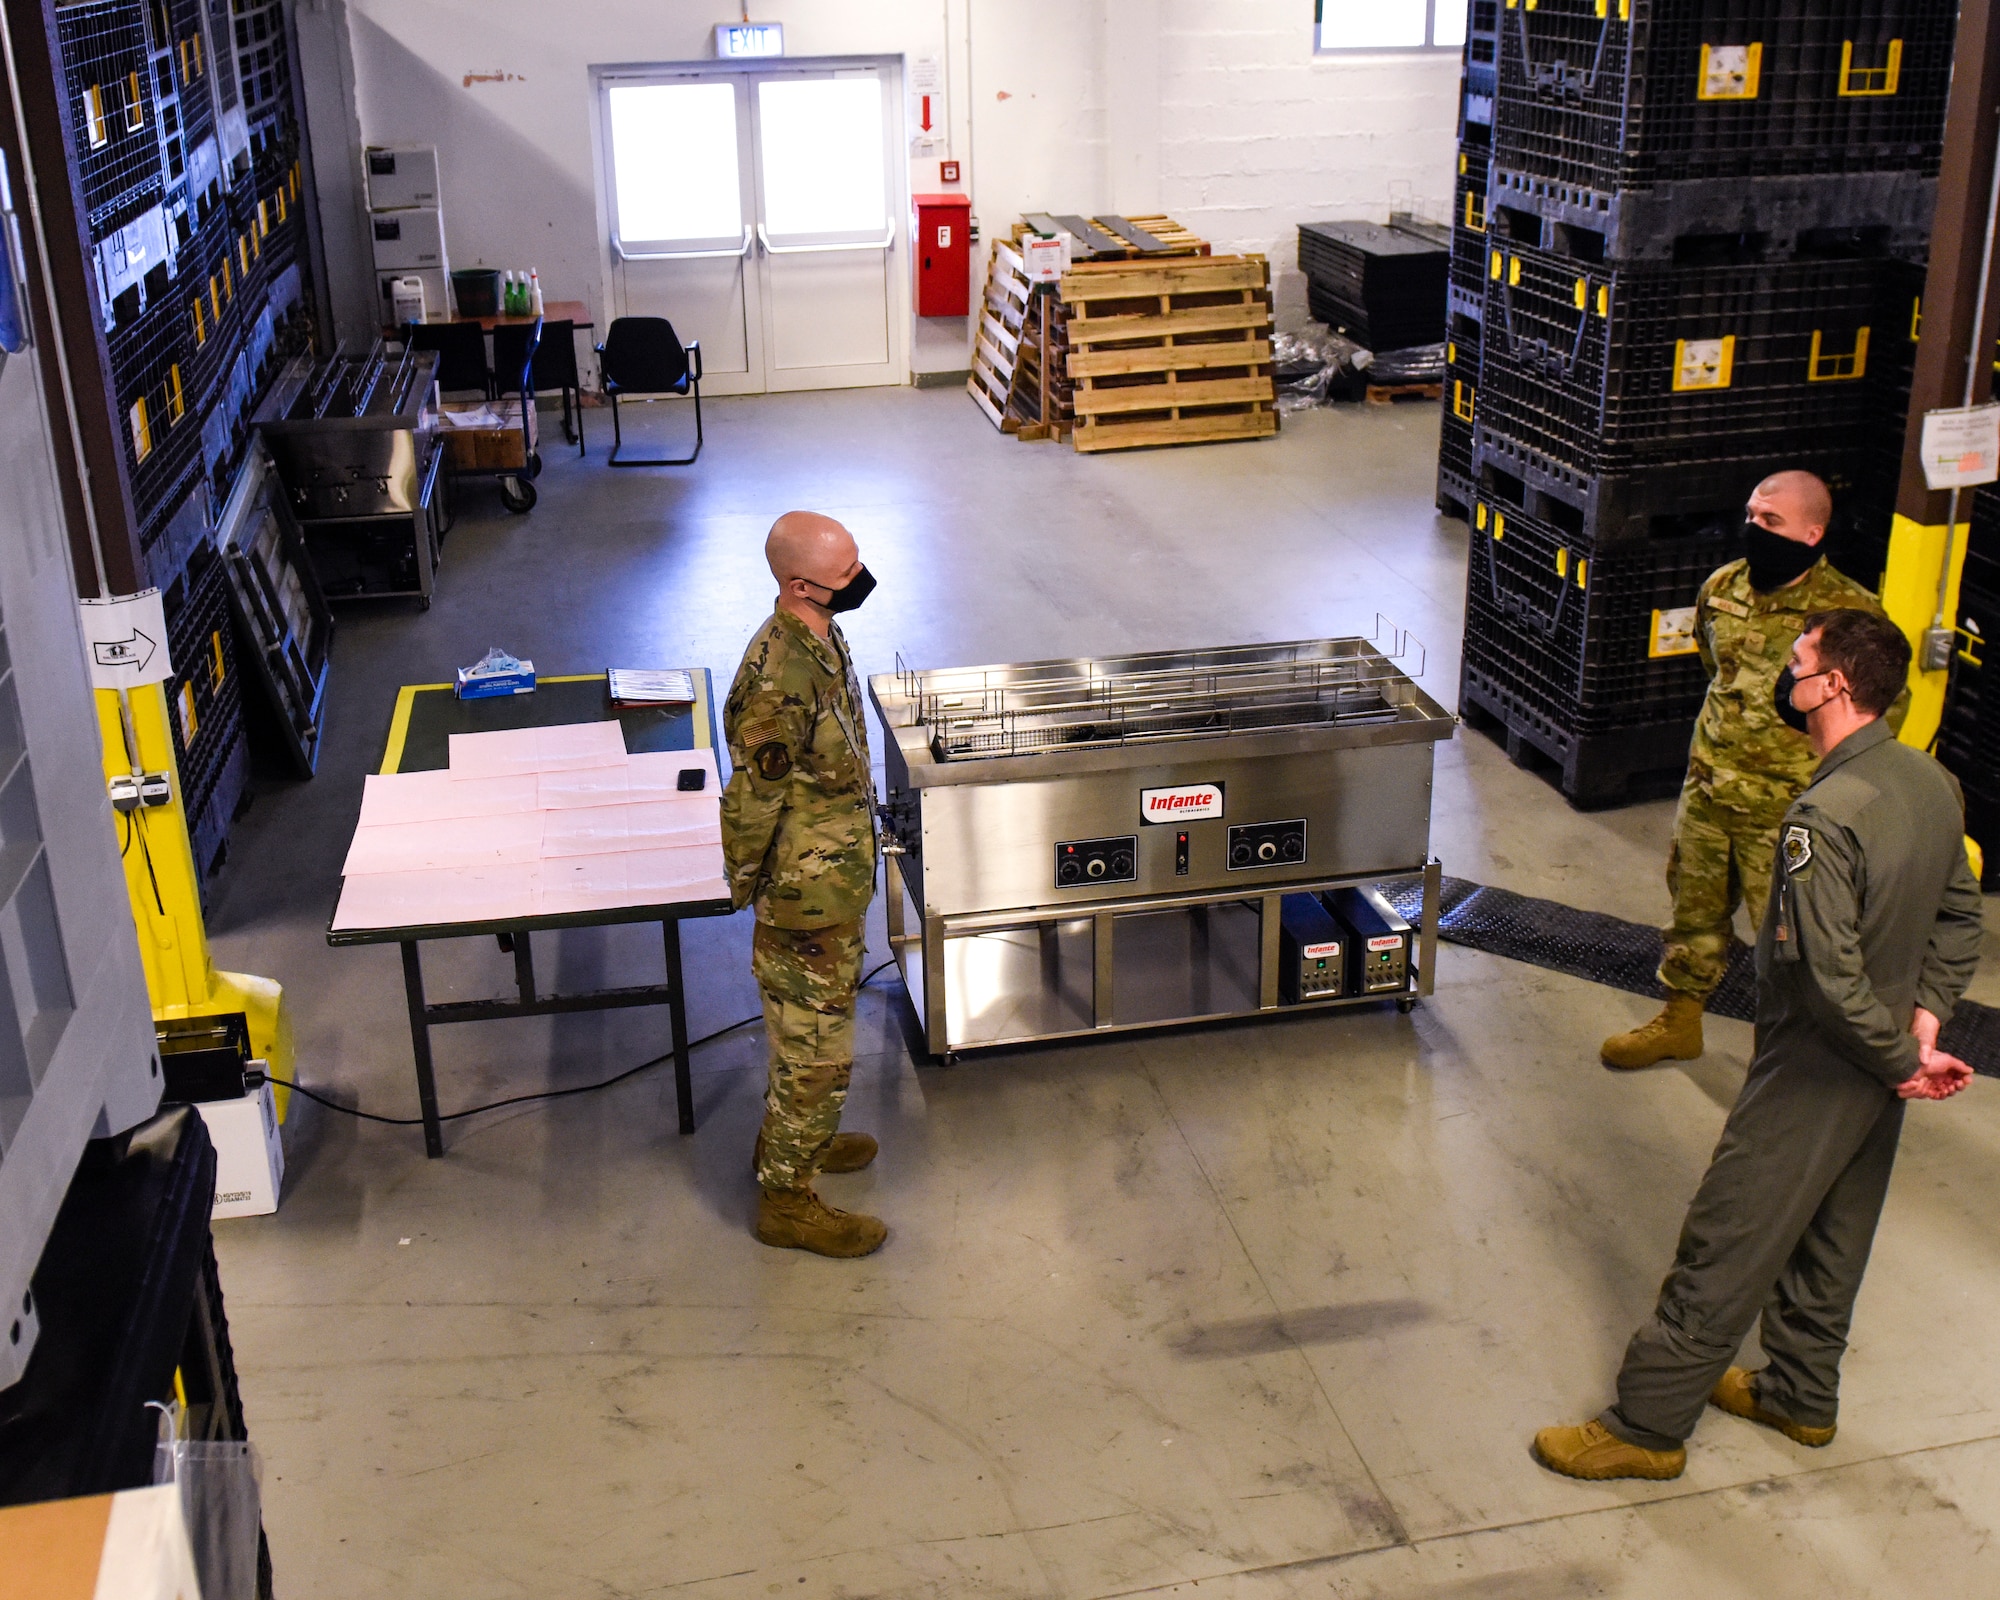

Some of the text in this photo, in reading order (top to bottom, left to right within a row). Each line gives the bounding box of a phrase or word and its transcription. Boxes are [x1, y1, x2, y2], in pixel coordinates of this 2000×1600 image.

[729, 27, 768, 53] EXIT
[940, 228, 948, 243] F
[1150, 793, 1213, 811] Infante
[1307, 944, 1336, 954] Infante
[1371, 937, 1399, 947] Infante
